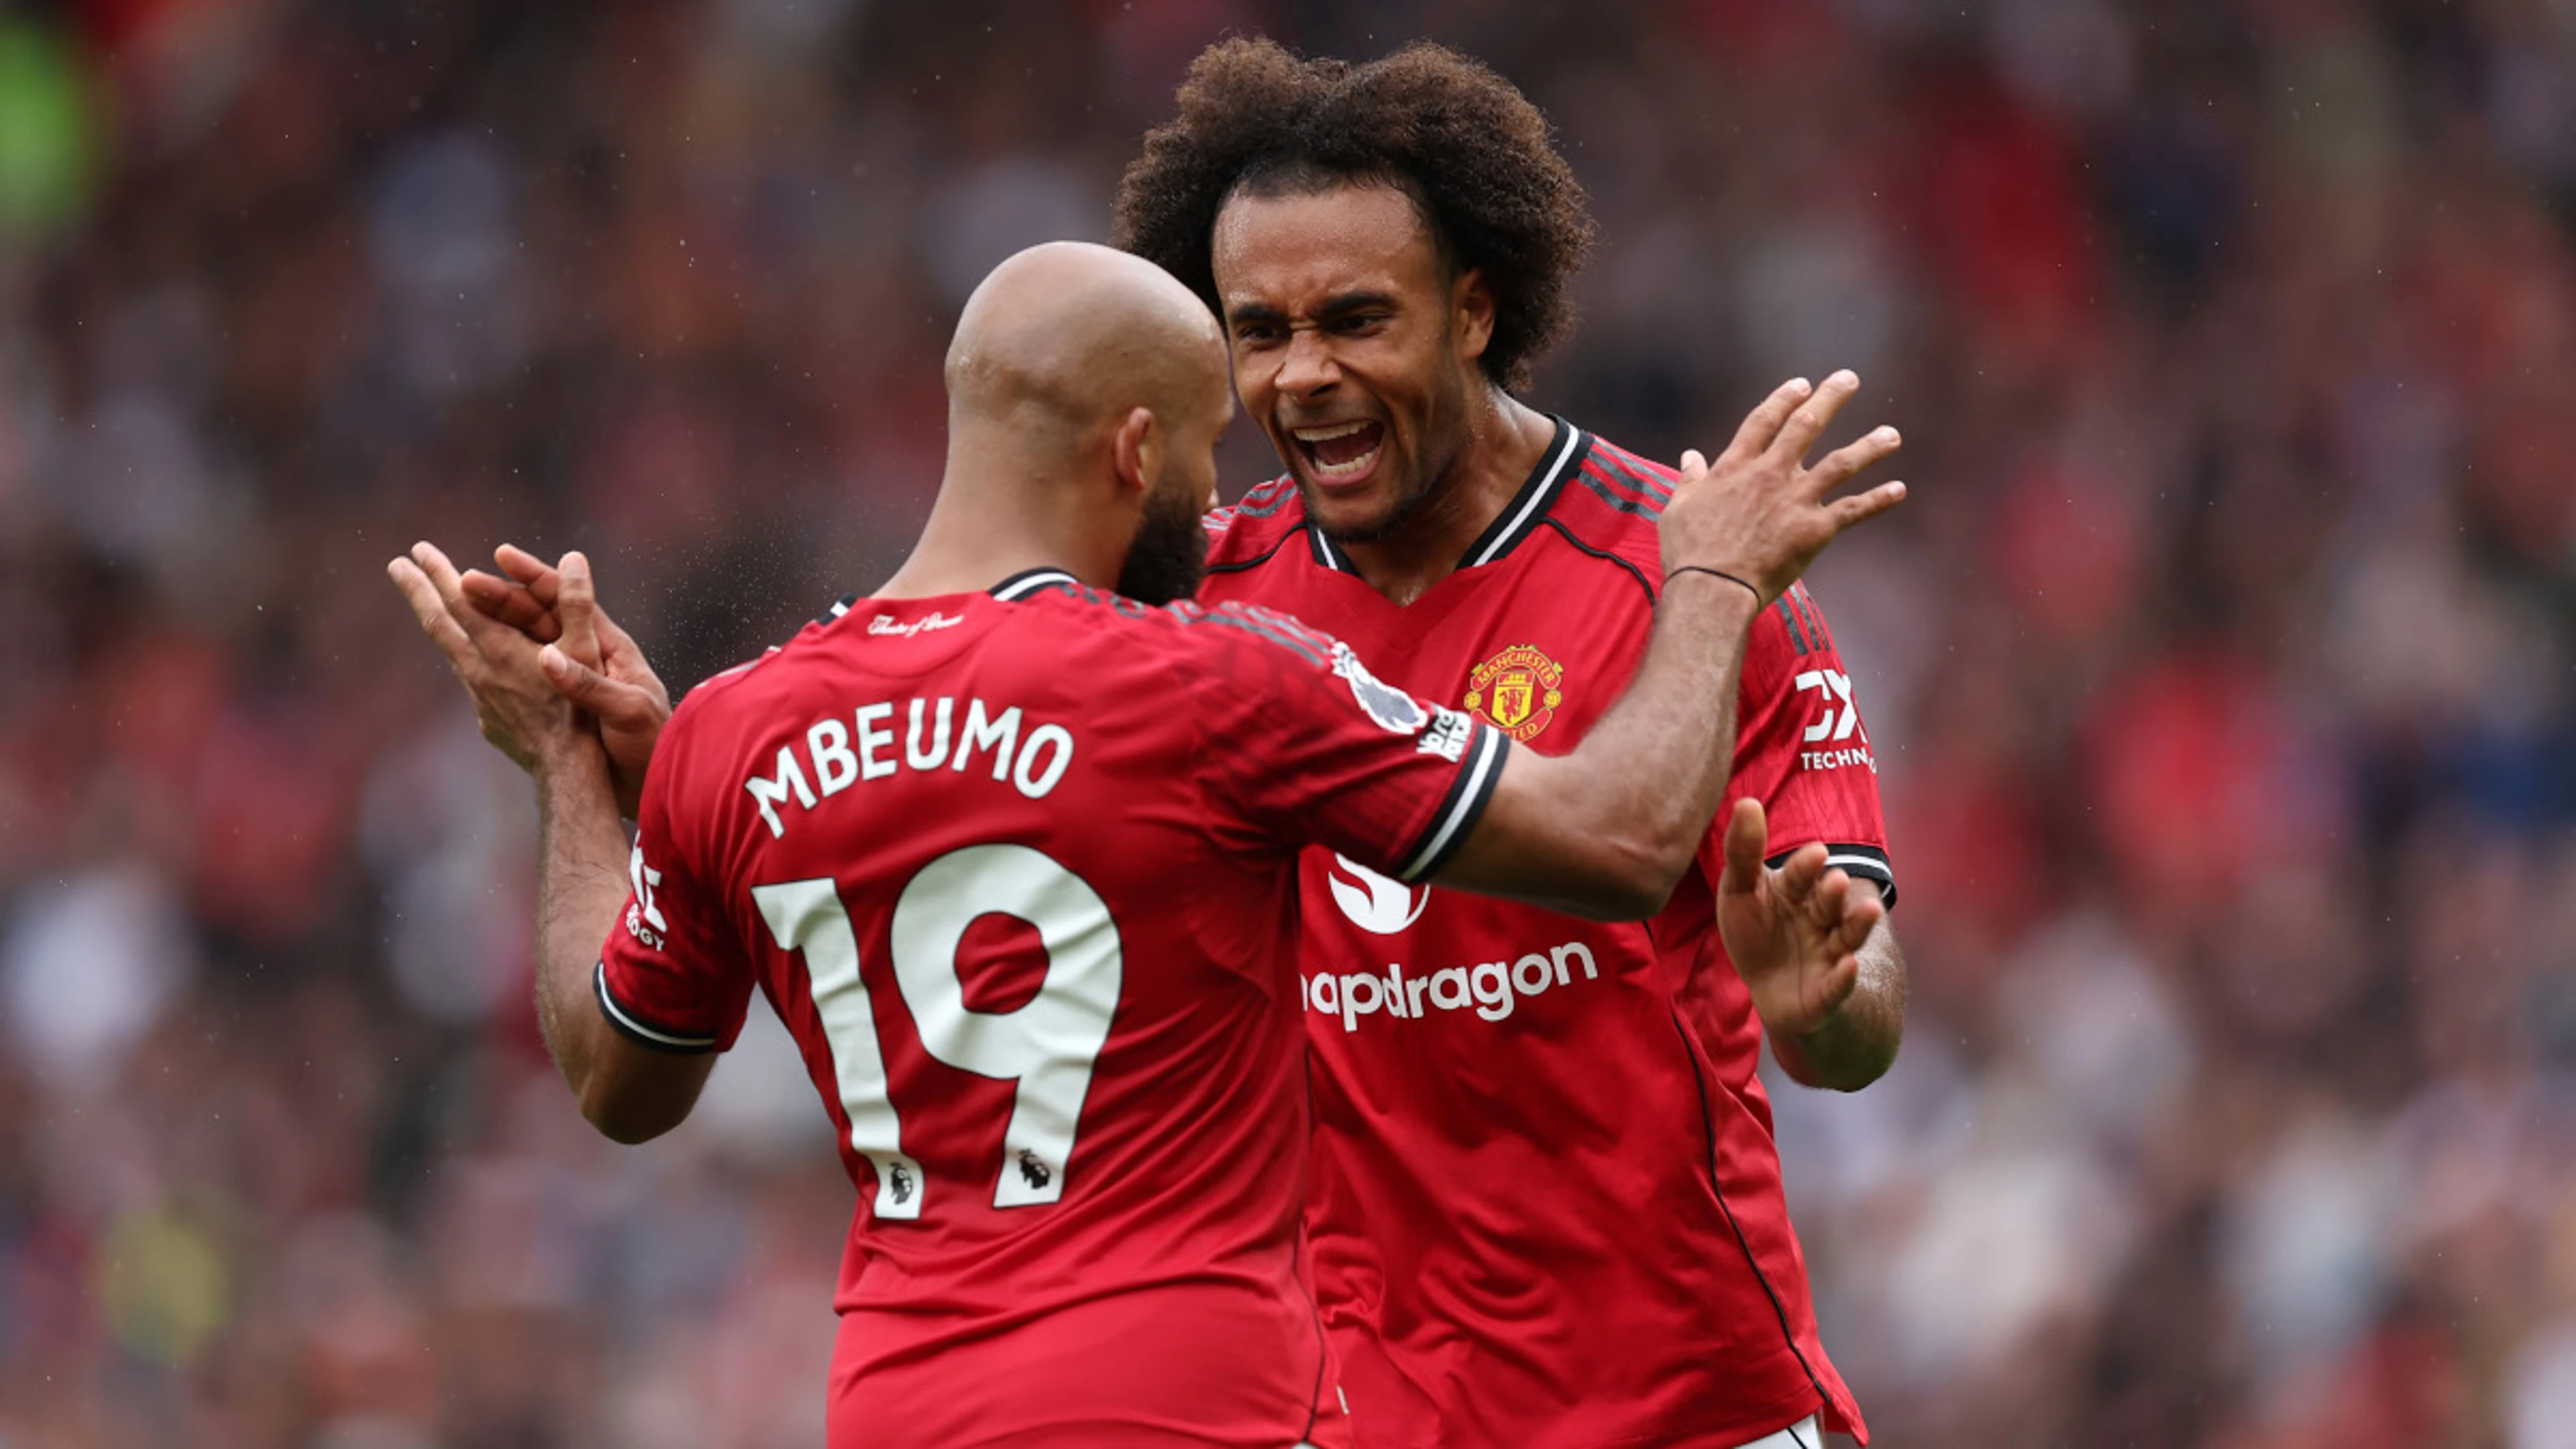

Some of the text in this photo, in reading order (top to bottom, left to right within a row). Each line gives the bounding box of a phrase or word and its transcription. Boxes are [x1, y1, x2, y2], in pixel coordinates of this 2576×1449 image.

[1478, 652, 1555, 684] MANCHESTER
[745, 697, 1074, 840] MBEUMO
[751, 843, 1123, 1219] 19
[1300, 942, 1599, 1032] apdragon
